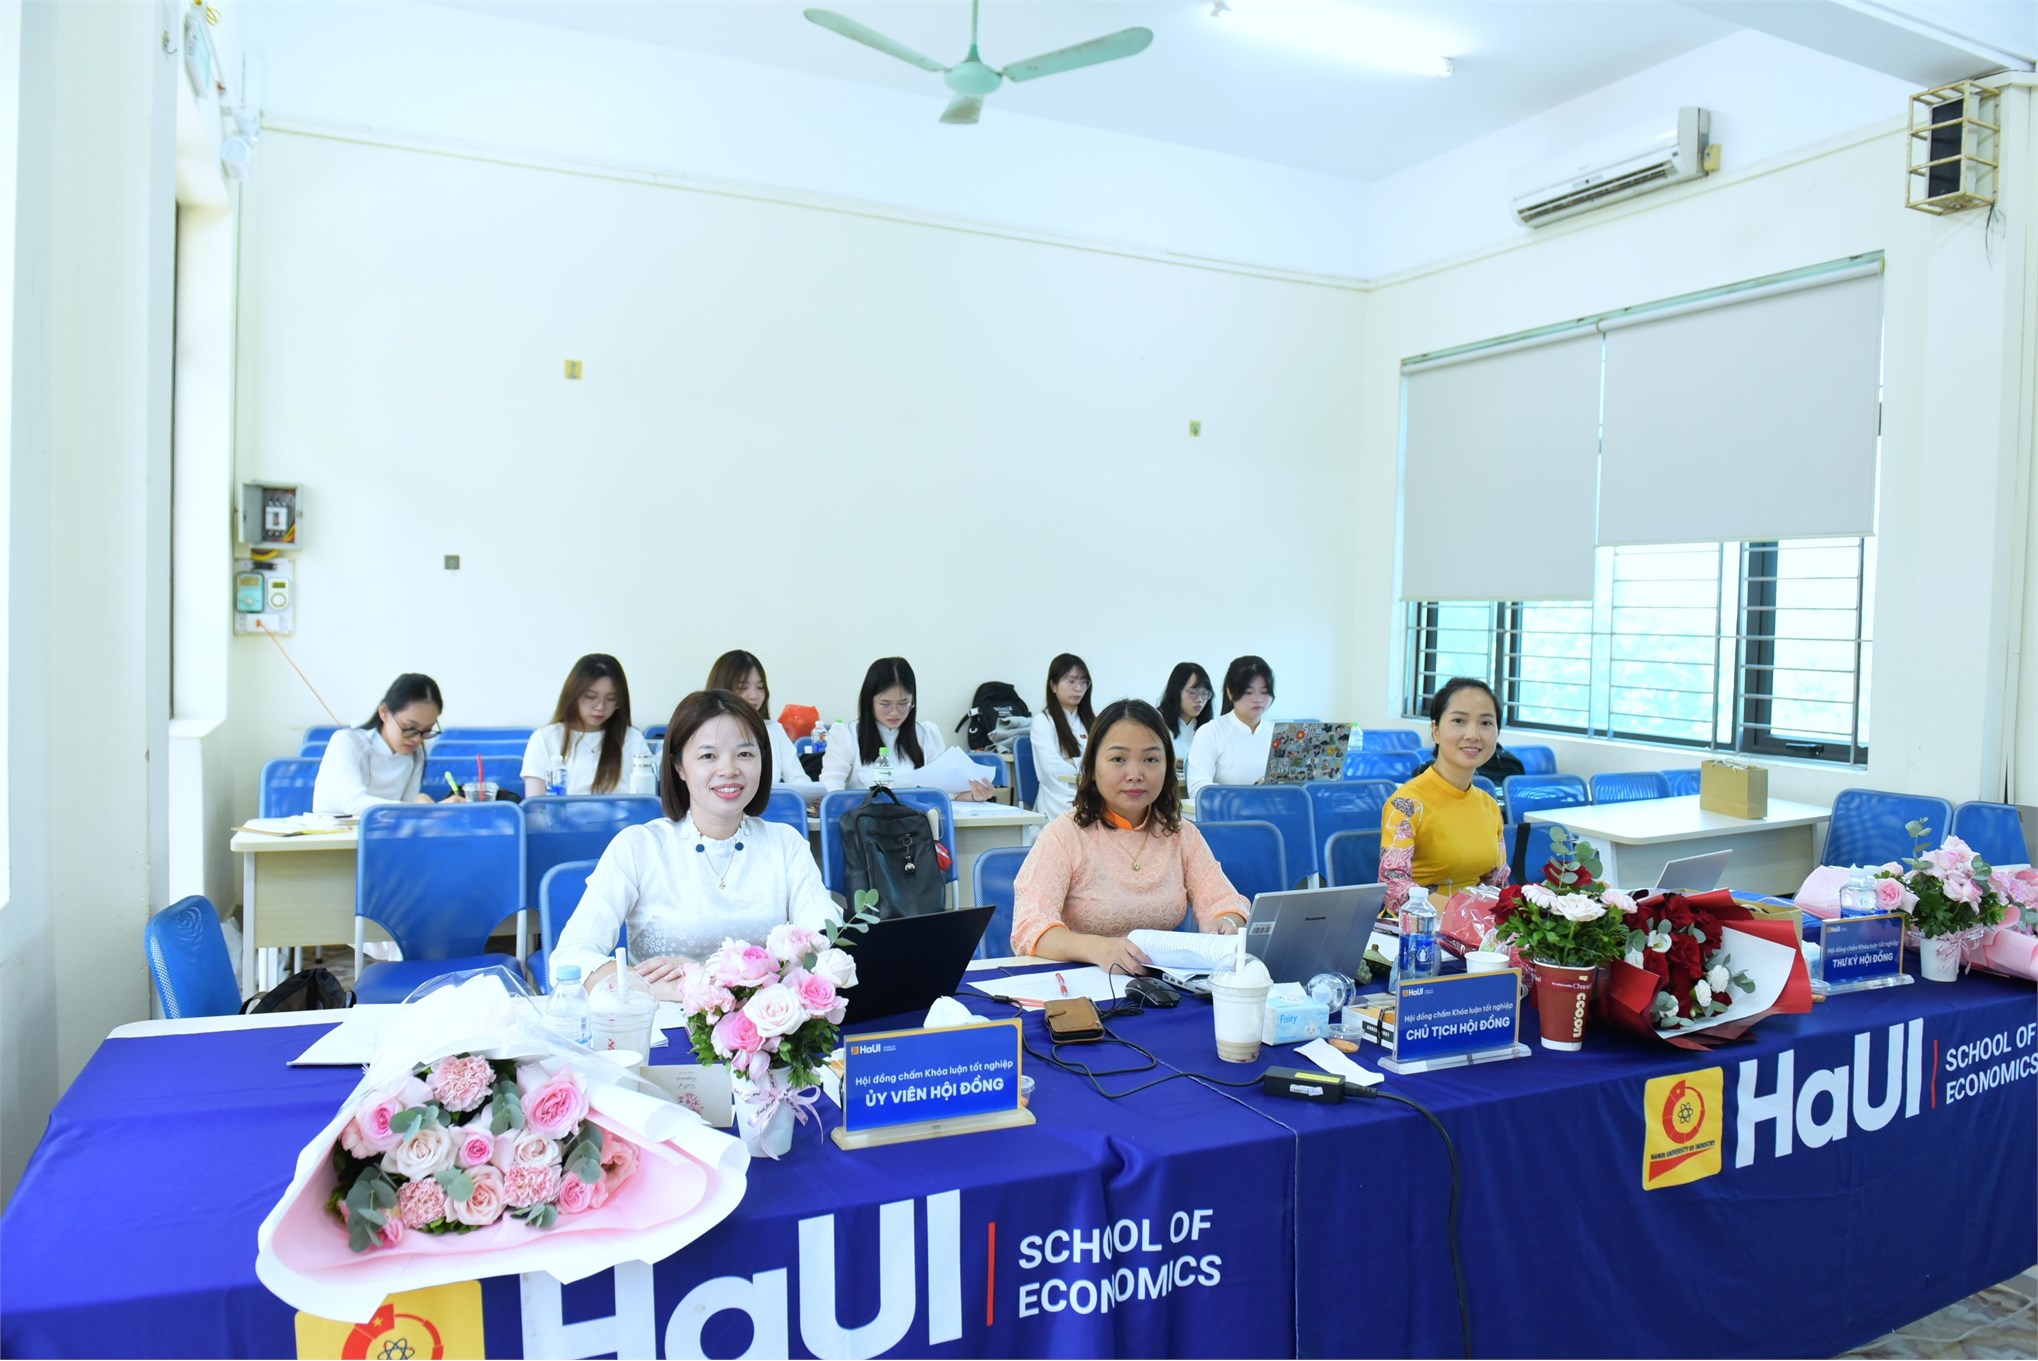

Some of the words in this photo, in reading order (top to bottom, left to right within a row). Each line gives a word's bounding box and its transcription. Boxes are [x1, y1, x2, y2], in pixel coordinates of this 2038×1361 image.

[1832, 956, 1848, 968] THƯ
[1859, 953, 1872, 967] HỘI
[1872, 950, 1894, 963] ĐỒNG
[1404, 1014, 1416, 1024] Hội
[1416, 1012, 1433, 1021] đồng
[1433, 1009, 1451, 1019] chấm
[1452, 1008, 1469, 1016] Khóa
[1469, 1005, 1482, 1015] luận
[1482, 1003, 1492, 1012] tốt
[1492, 1001, 1514, 1012] nghiệp
[1406, 1023, 1430, 1041] CHỦ
[1431, 1023, 1458, 1040] TỊCH
[1459, 1018, 1478, 1036] HỘI
[1479, 1013, 1511, 1031] ĐỒNG
[860, 1043, 881, 1055] HaUI
[1945, 1031, 2012, 1072] SCHOOL
[2016, 1022, 2037, 1049] OF
[855, 1075, 871, 1087] Hội
[872, 1072, 897, 1084] đồng
[898, 1069, 923, 1081] chấm
[924, 1066, 948, 1078] Khóa
[949, 1064, 968, 1075] luận
[969, 1061, 983, 1072] tốt
[983, 1059, 1014, 1072] nghiệp
[1946, 1052, 2037, 1105] ECONOMICS
[865, 1089, 888, 1107] ỦY
[890, 1085, 927, 1104] VIÊN
[930, 1081, 957, 1101] HỘI
[959, 1075, 1004, 1095] ĐỒNG
[1735, 1017, 1924, 1169] HaUI
[1666, 1146, 1689, 1158] UNIVERSITY
[1018, 1218, 1163, 1270] SCHOOL
[1169, 1208, 1214, 1244] OF
[519, 1189, 962, 1359] HaUI
[1019, 1254, 1222, 1319] ECONOMICS
